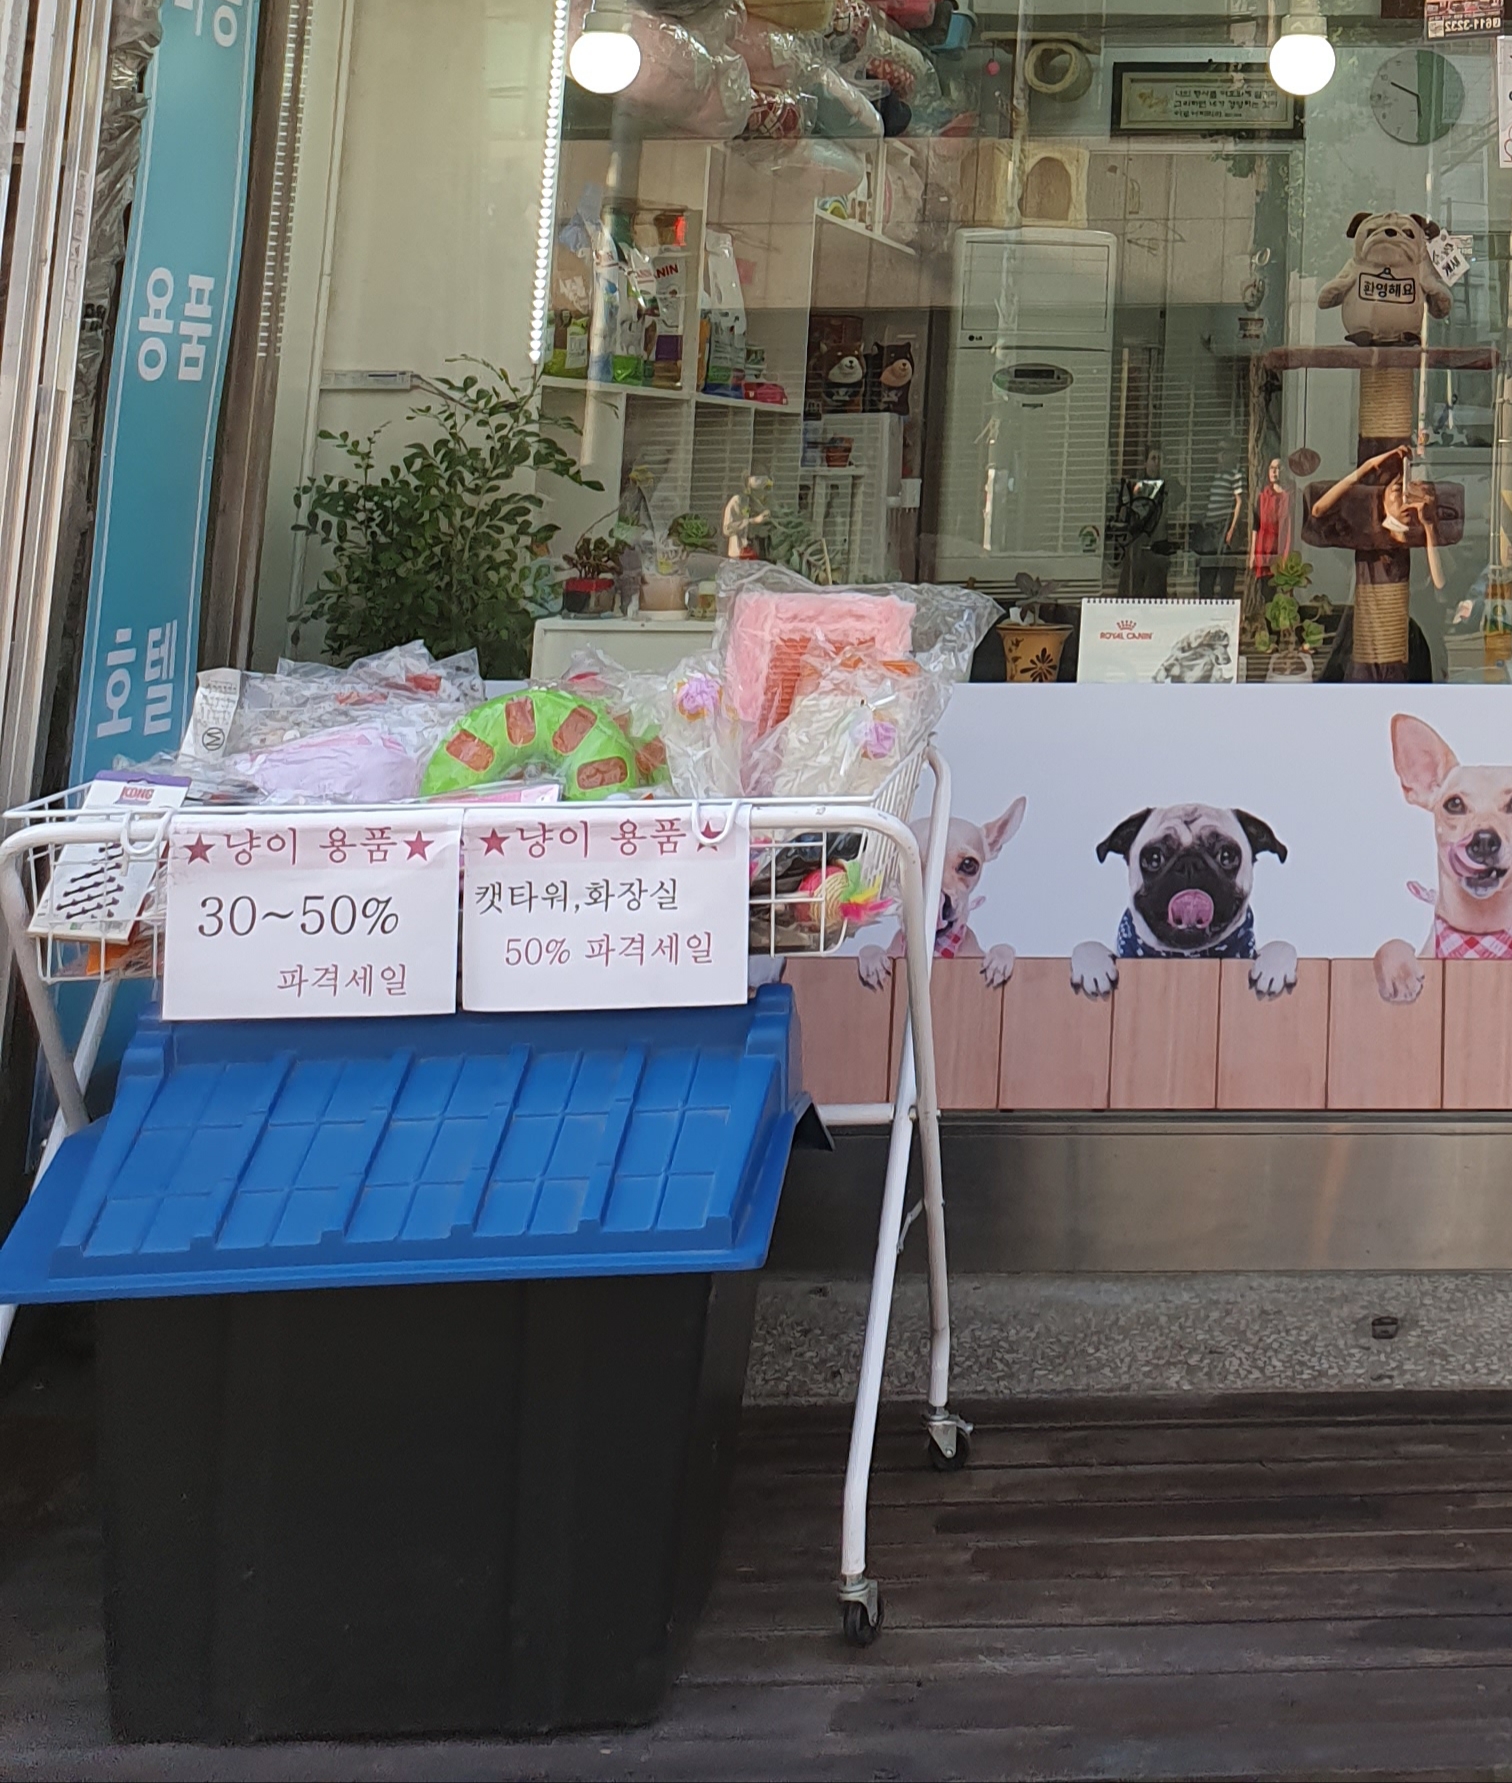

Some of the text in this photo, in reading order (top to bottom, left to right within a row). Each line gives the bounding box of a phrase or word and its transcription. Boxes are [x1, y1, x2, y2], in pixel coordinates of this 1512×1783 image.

[1363, 280, 1414, 298] 환영해요
[137, 265, 216, 383] 용품
[1099, 631, 1153, 641] ROYAL CANIN
[96, 618, 179, 739] 호텔
[121, 785, 155, 801] KONG
[224, 824, 400, 867] 냥이 용품
[516, 817, 687, 861] 냥이 용품
[196, 893, 401, 939] 30~50%
[504, 929, 715, 969] 50% 파격세일
[276, 963, 409, 999] 파격세일
